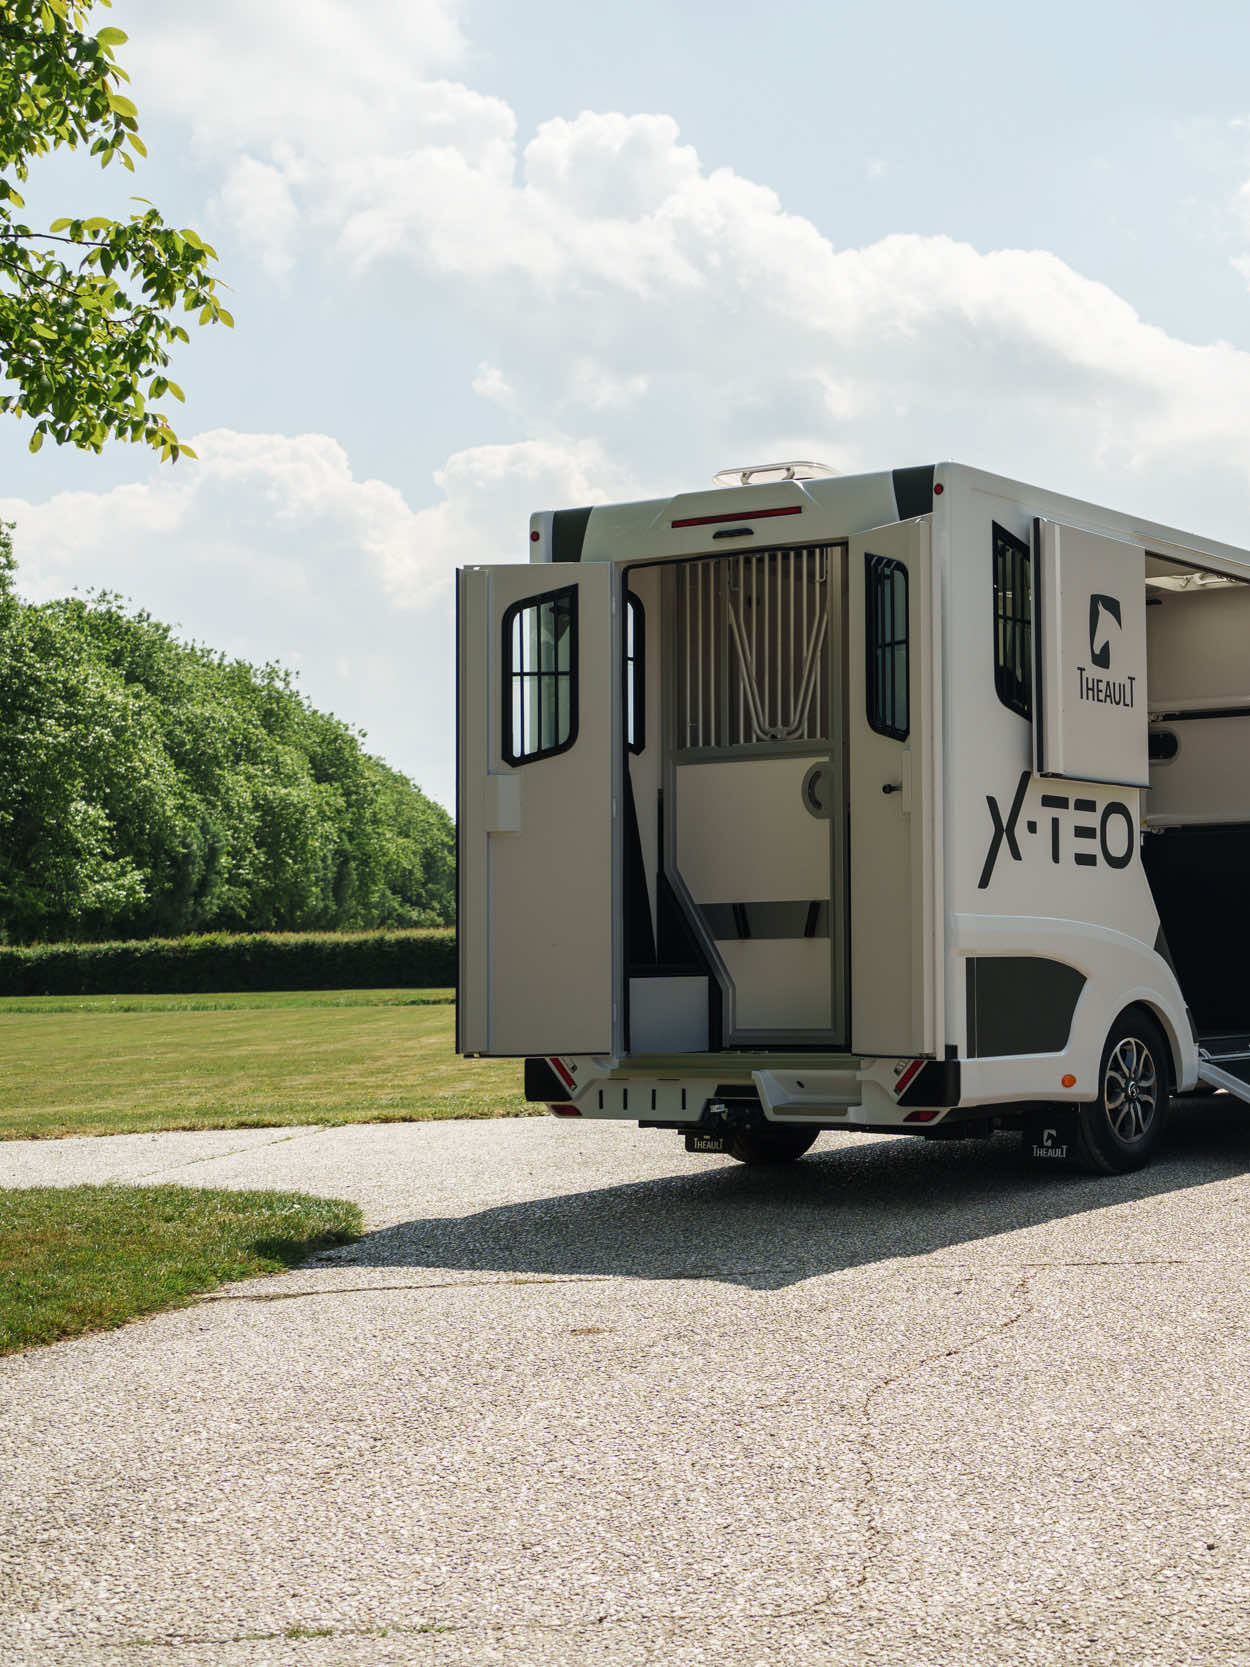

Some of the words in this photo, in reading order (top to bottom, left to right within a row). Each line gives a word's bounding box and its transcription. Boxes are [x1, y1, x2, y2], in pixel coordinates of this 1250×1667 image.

[1077, 666, 1135, 708] THEAULT
[694, 1137, 723, 1150] THEAULT
[1032, 1144, 1068, 1158] THEAULT
